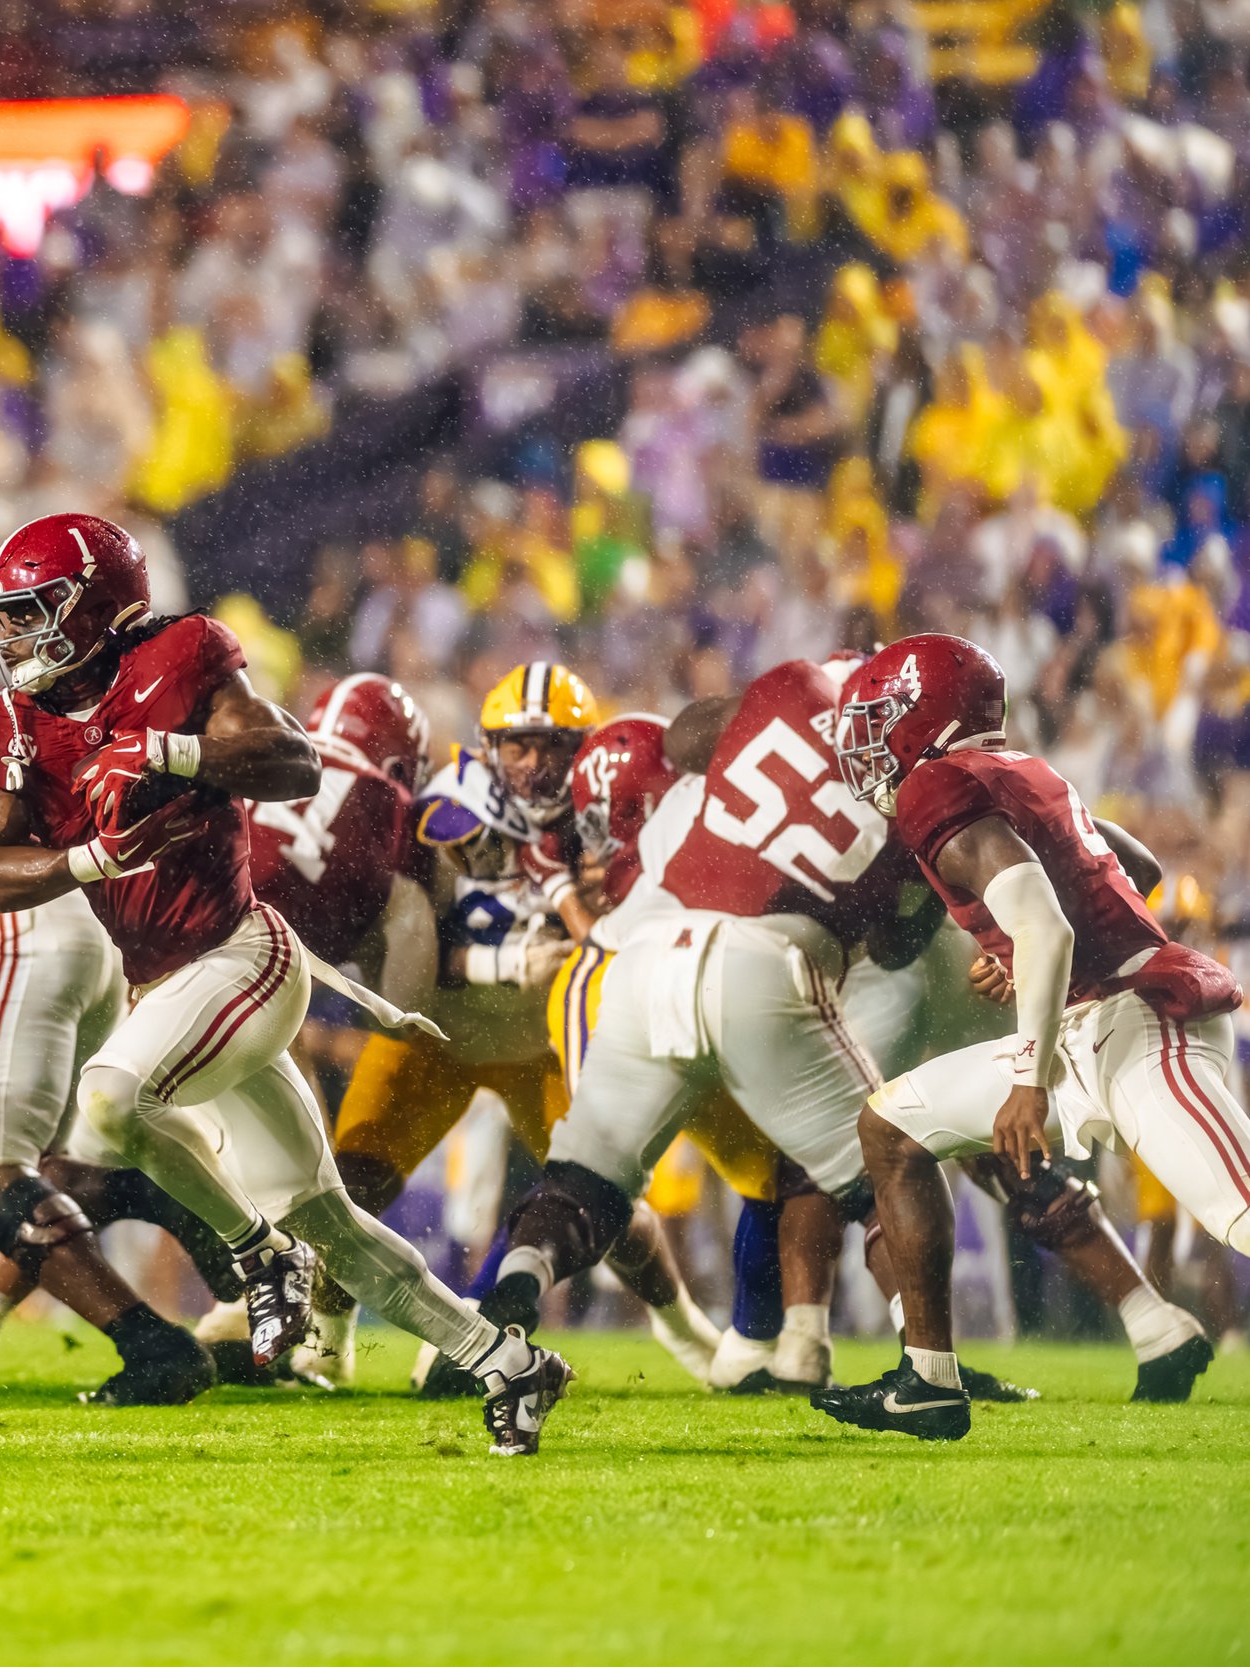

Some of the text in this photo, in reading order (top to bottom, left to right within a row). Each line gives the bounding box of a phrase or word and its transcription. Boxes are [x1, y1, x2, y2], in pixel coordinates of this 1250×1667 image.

[68, 528, 96, 564] 1
[900, 654, 922, 690] 4
[703, 716, 888, 902] 52
